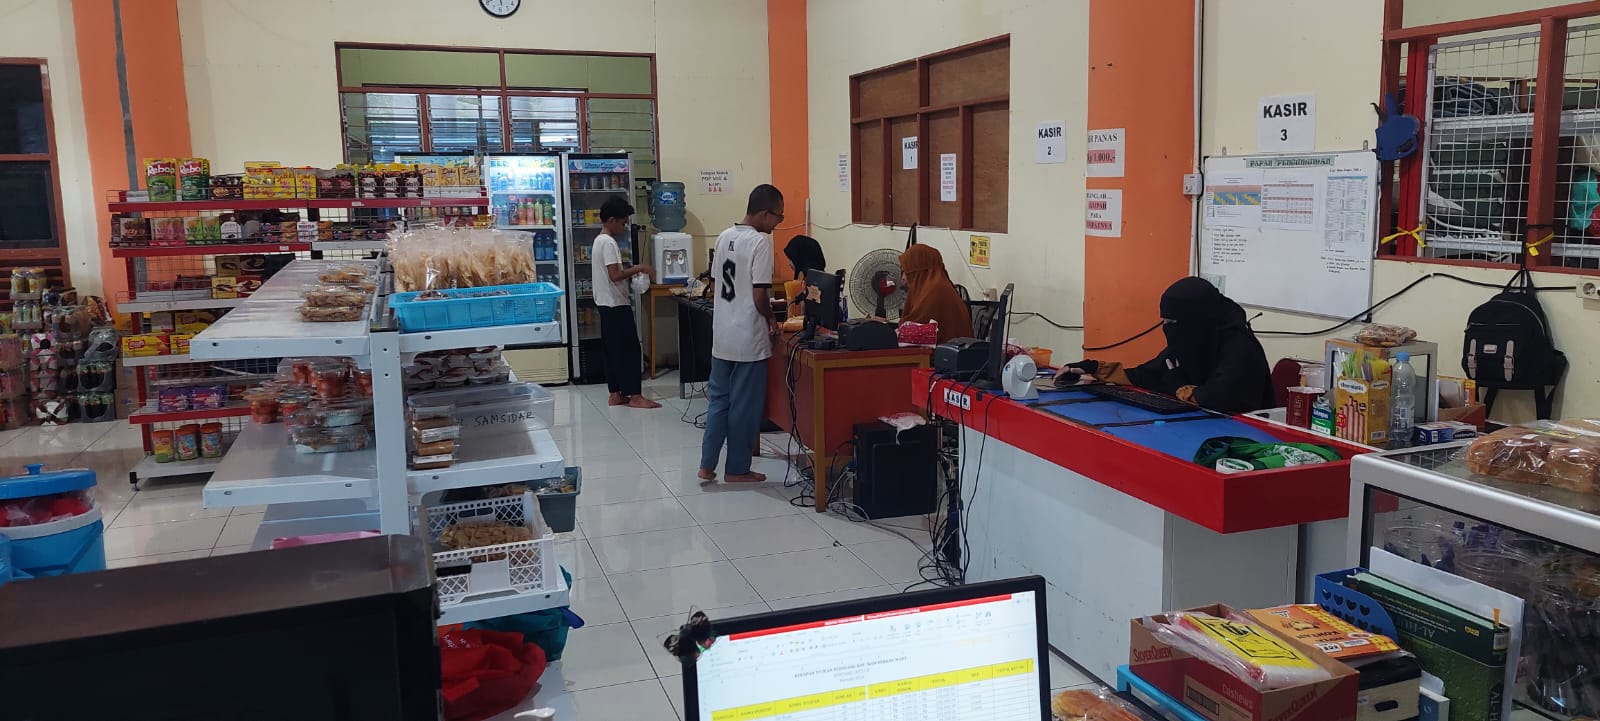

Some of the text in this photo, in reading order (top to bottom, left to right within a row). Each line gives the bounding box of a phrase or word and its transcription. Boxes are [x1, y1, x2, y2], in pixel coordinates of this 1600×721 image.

[1263, 102, 1308, 119] KASIR
[1038, 127, 1062, 139] KASIR
[1094, 133, 1118, 143] PANAS
[1280, 129, 1288, 141] 3
[1047, 146, 1052, 155] 2
[946, 391, 968, 406] KASR
[474, 411, 535, 427] SAMSIDAR
